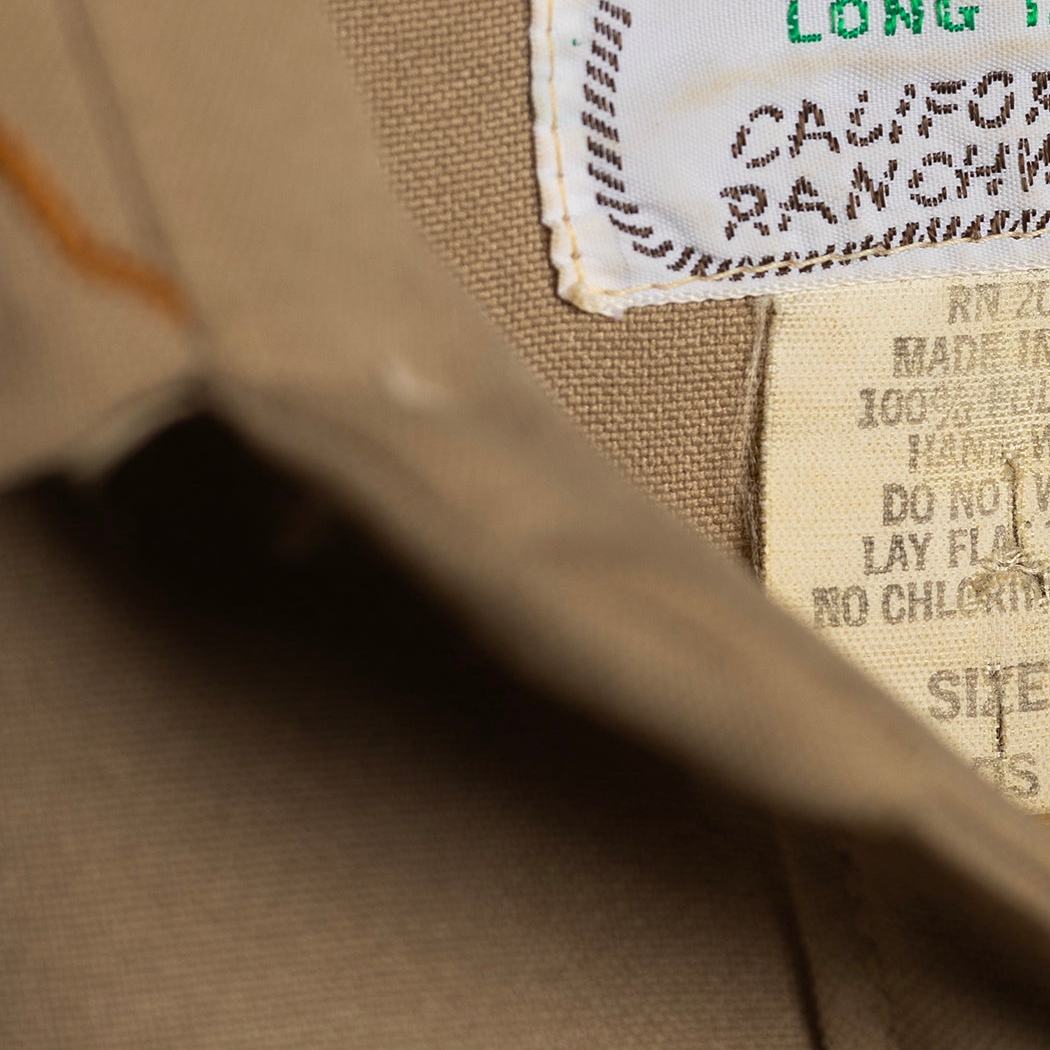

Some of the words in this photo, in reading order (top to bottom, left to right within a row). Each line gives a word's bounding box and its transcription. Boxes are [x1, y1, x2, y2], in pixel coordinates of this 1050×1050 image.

[948, 282, 1001, 324] RN
[892, 332, 1001, 378] MADE
[857, 383, 973, 431] 100%
[881, 482, 935, 527] DO
[949, 477, 1011, 520] NO
[862, 532, 933, 576] LAY
[948, 520, 1020, 568] FLA
[811, 584, 869, 628] NO
